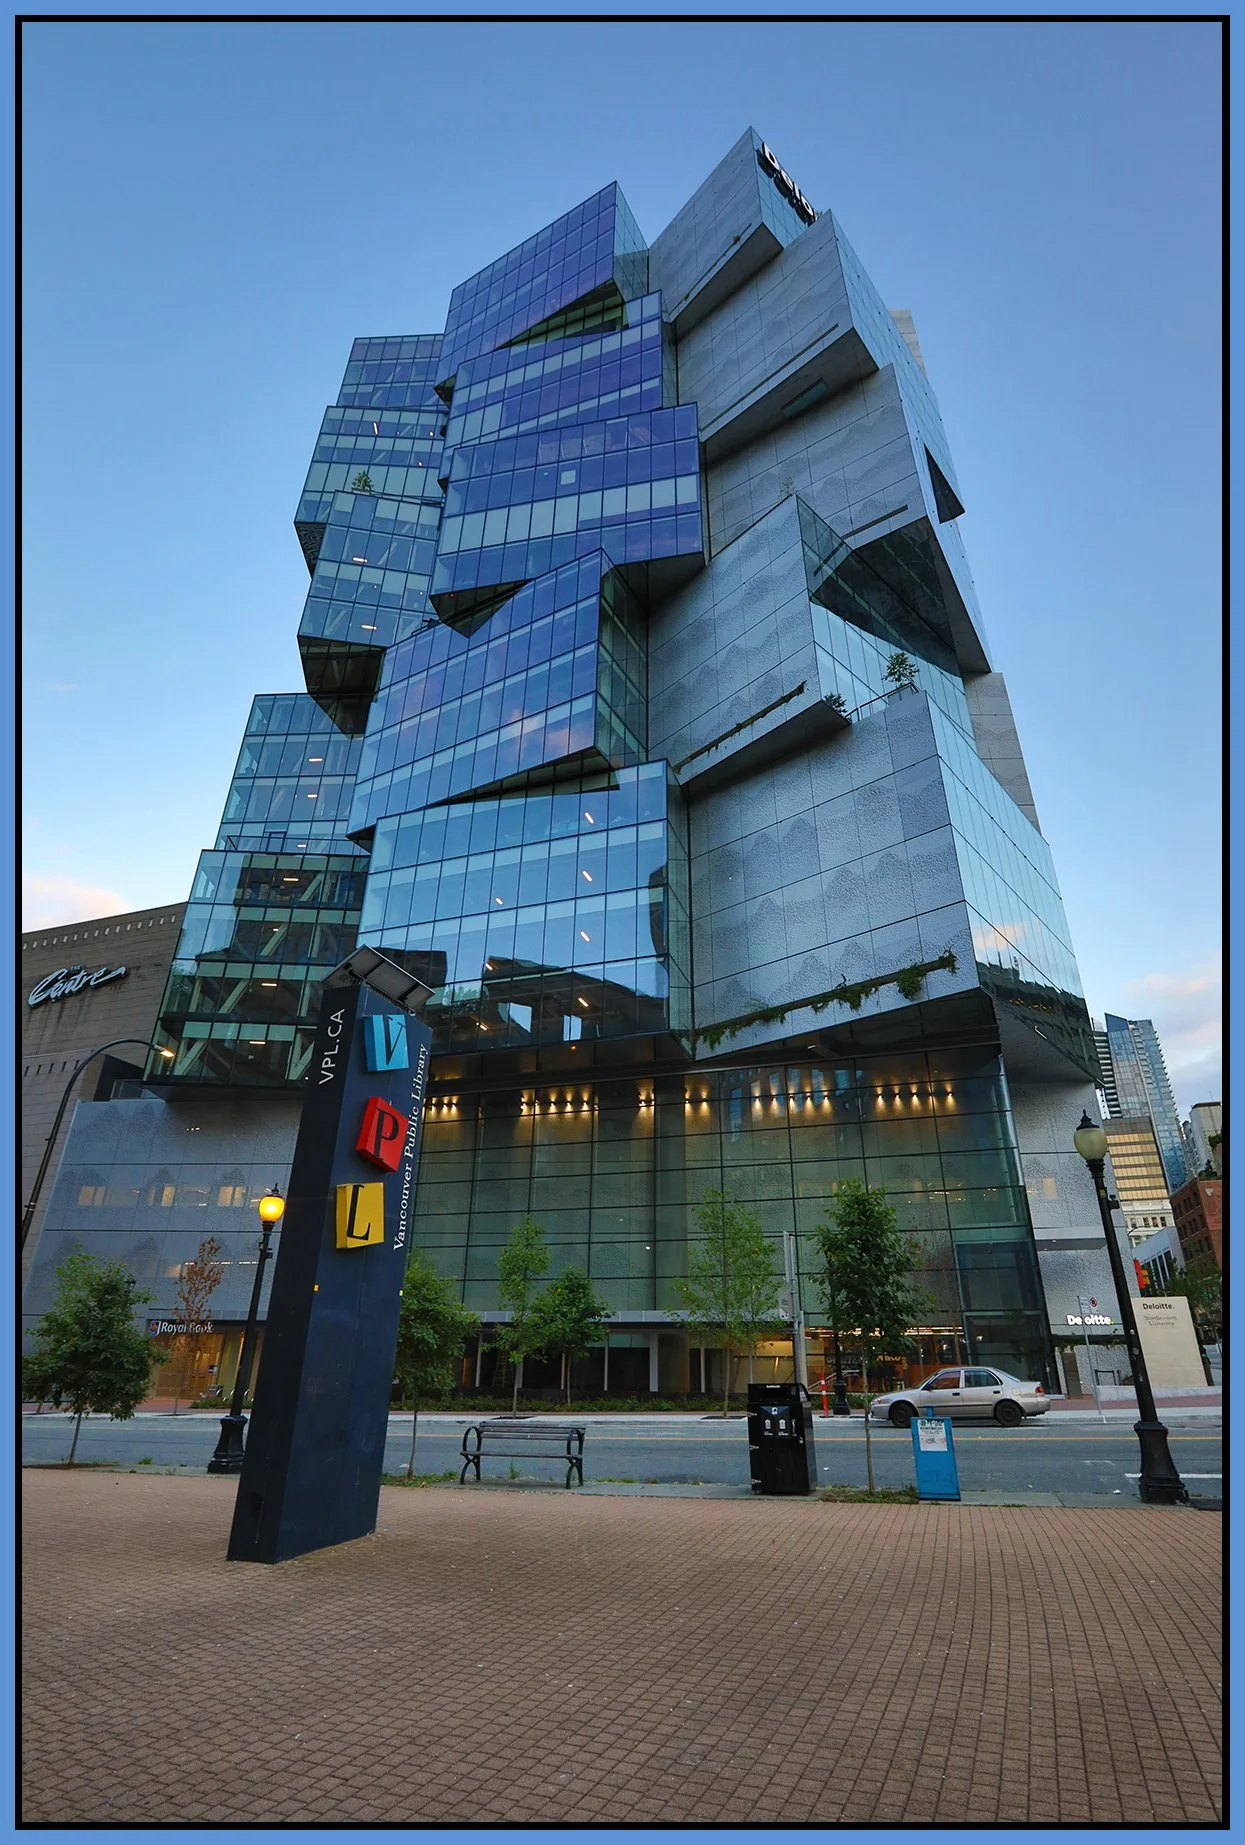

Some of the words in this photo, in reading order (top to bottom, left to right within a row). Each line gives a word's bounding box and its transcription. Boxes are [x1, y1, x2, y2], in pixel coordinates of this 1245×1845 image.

[28, 966, 127, 1006] Centre
[318, 1008, 346, 1085] VPL.CA
[382, 1014, 406, 1066] V
[410, 1043, 429, 1101] Library
[373, 1106, 399, 1162] P
[403, 1105, 420, 1160] Public
[346, 1184, 372, 1241] L
[392, 1163, 413, 1251] Vancouver
[161, 1322, 187, 1336] Royal
[1066, 1314, 1114, 1326] Deoitte.
